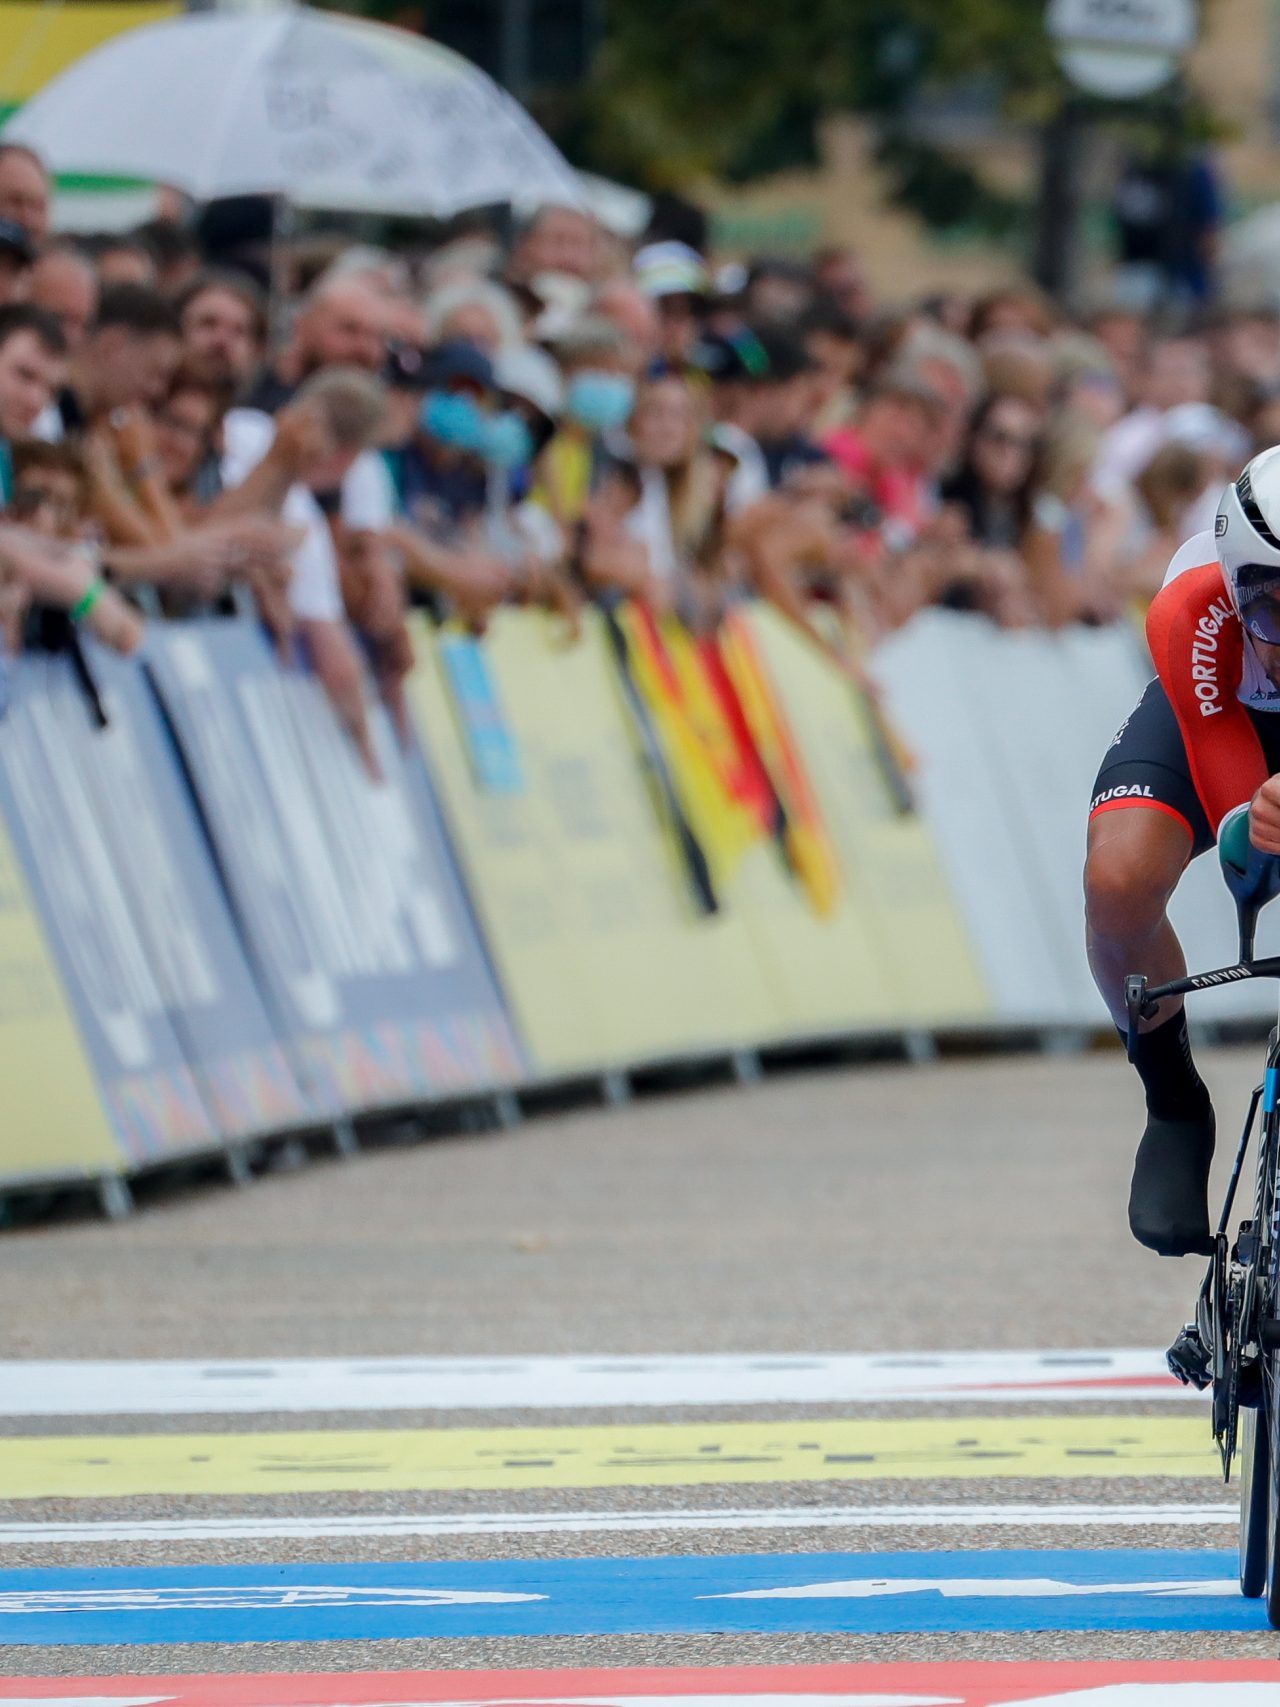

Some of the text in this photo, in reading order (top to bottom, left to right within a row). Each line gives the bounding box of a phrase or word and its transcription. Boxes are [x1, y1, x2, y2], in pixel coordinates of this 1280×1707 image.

[1192, 596, 1235, 717] PORTUGAL
[1090, 784, 1154, 811] TUGAL
[1191, 967, 1252, 988] CANYON
